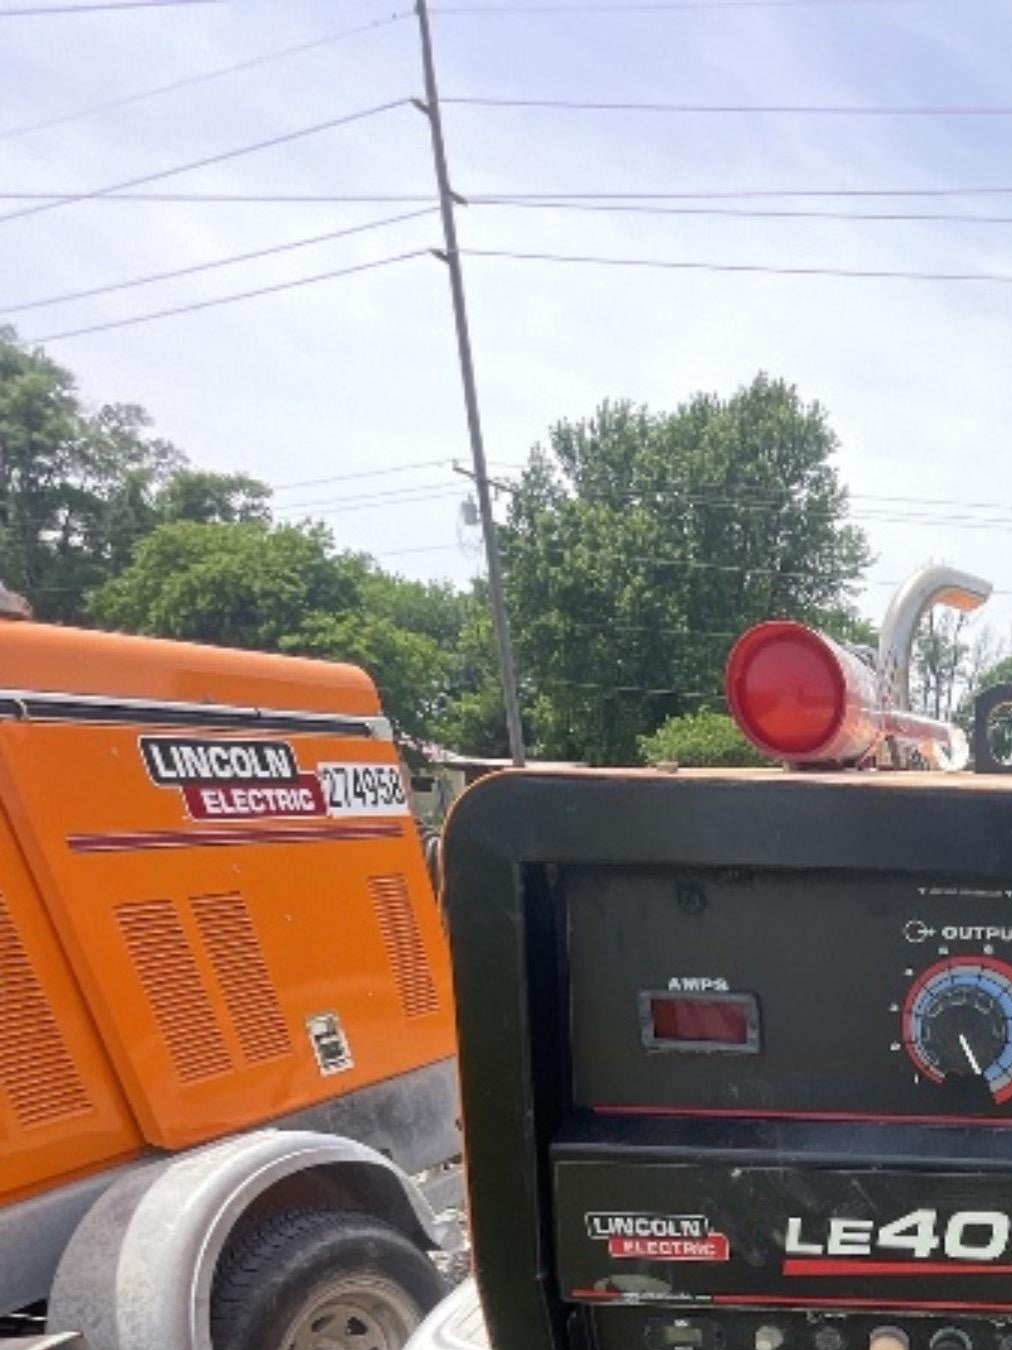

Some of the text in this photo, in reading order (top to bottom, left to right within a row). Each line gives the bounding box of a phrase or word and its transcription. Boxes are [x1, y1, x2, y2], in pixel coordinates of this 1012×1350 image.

[150, 744, 291, 778] LINCOLN
[323, 767, 405, 807] 274958
[200, 788, 315, 814] ELECTRIC
[667, 976, 729, 991] AMPS
[593, 1217, 701, 1237] LINCOLN
[623, 1241, 716, 1255] ELECTRIC
